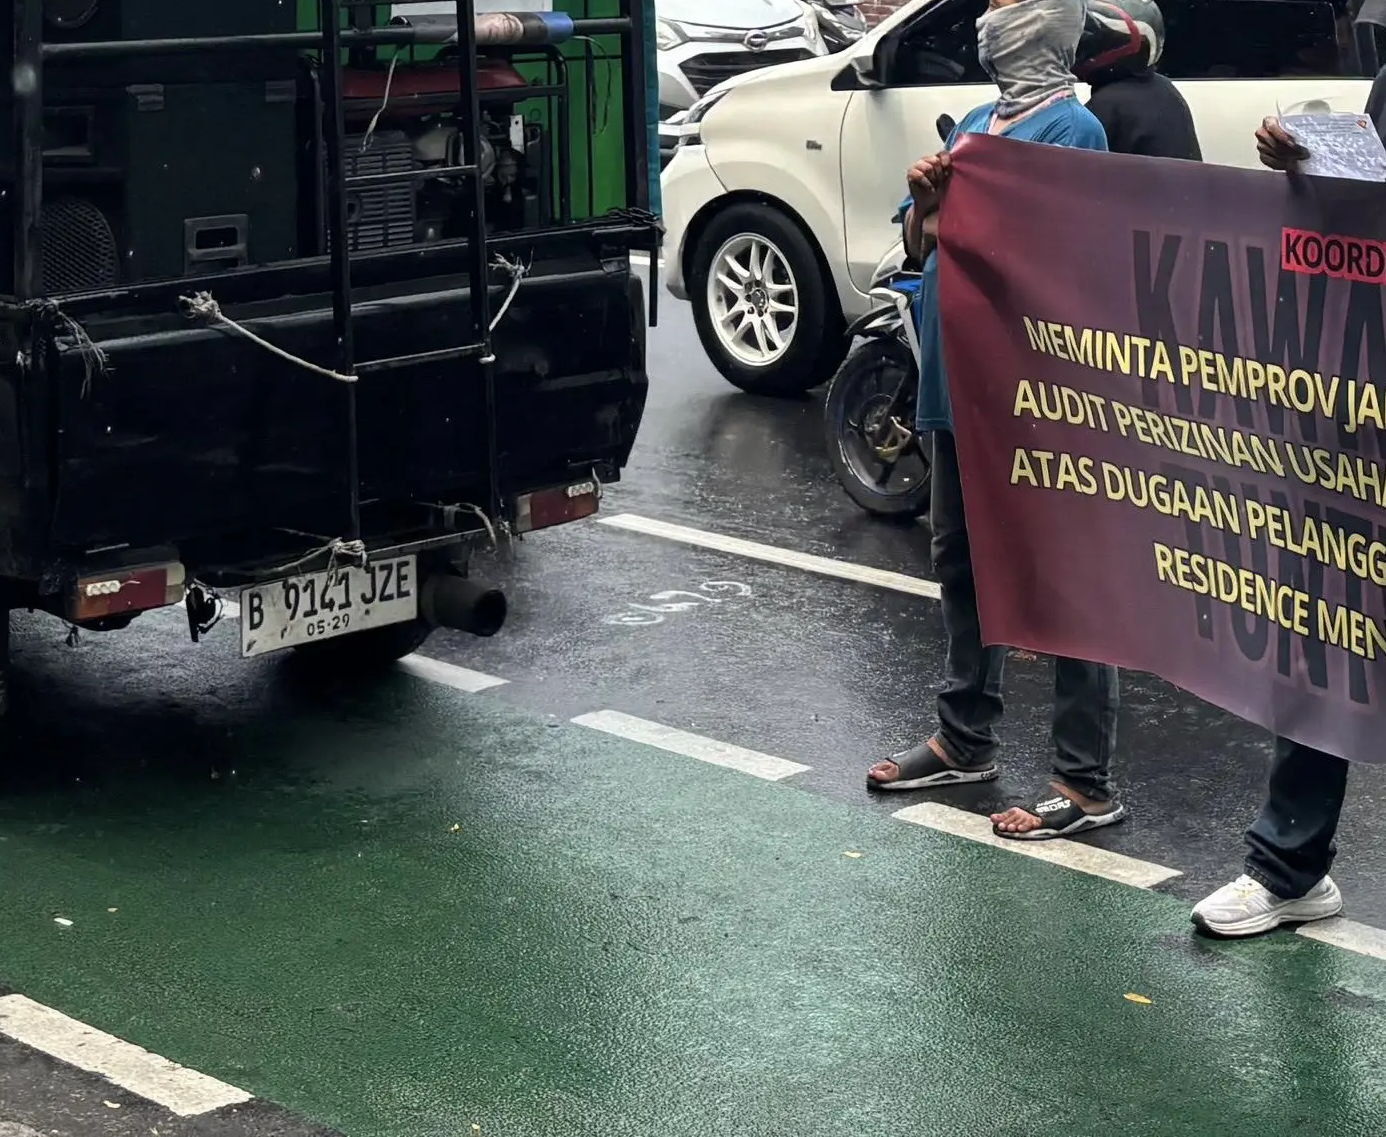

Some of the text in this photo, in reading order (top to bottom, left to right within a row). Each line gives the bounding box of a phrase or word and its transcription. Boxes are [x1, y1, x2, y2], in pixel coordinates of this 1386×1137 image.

[1022, 315, 1175, 385] MEMINTA
[1181, 344, 1339, 419] PEMPROV
[1012, 378, 1109, 432] AUDIT
[1112, 399, 1286, 476] PERIZINAN
[1010, 447, 1099, 497] ATAS
[1103, 473, 1242, 536] DUGAAN
[249, 561, 411, 631] B 9141 JZE
[1153, 542, 1310, 636] RESIDENCE
